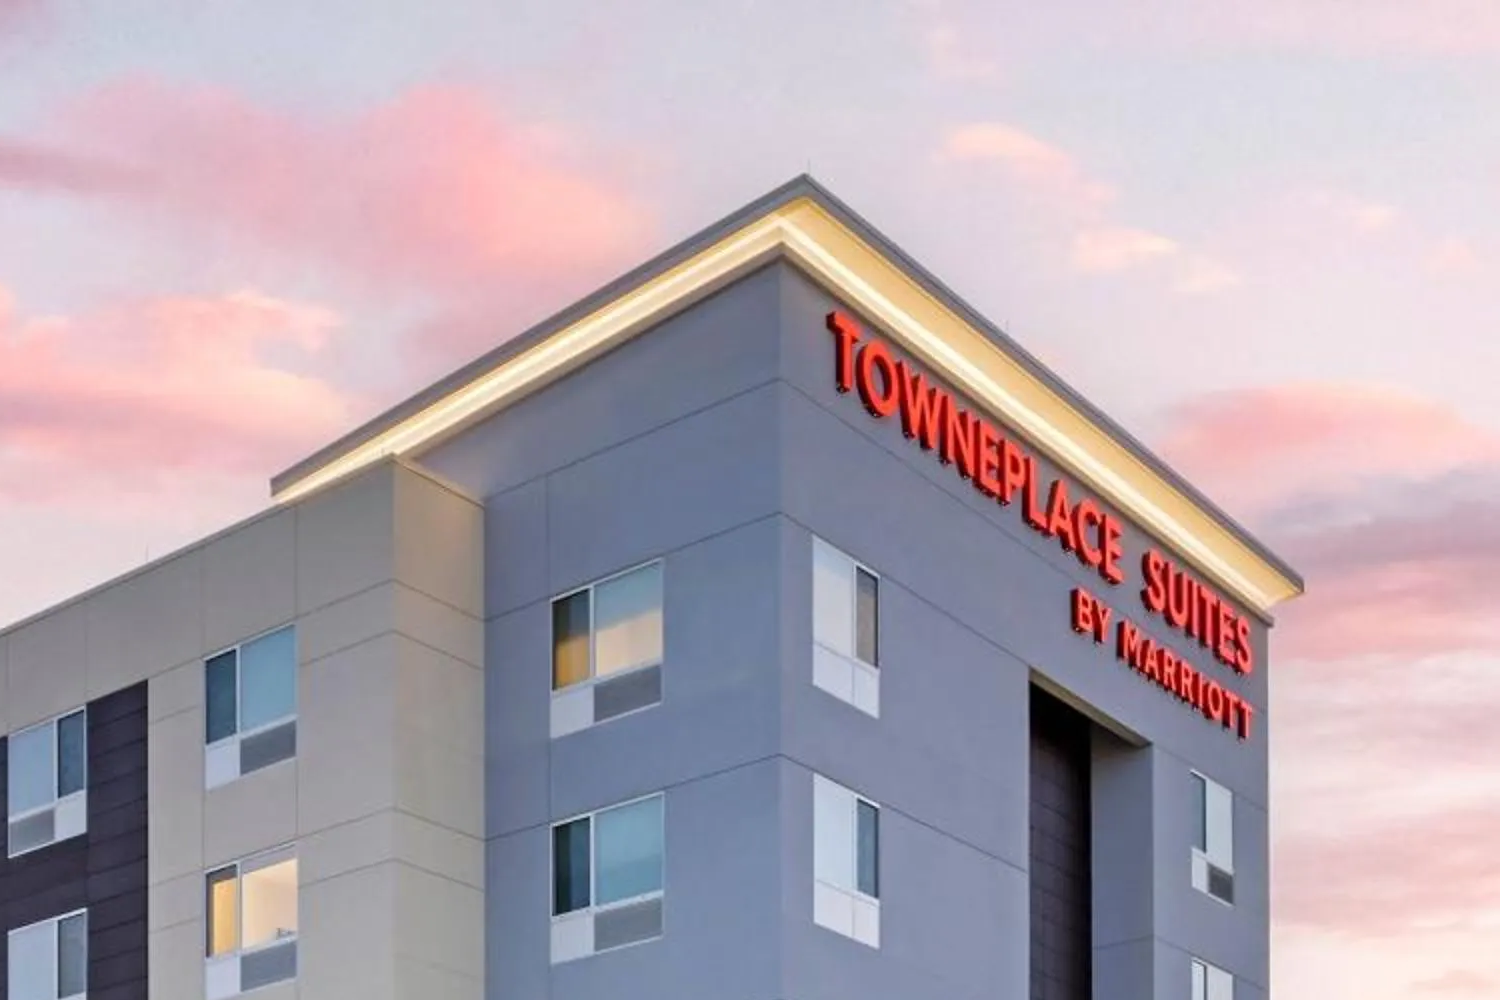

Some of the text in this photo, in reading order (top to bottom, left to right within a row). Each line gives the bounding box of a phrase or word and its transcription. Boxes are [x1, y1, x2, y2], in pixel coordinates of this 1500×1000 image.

[827, 310, 1253, 675] TOWNEPLACE SUITES
[1071, 586, 1253, 741] BY MARRIOTT
